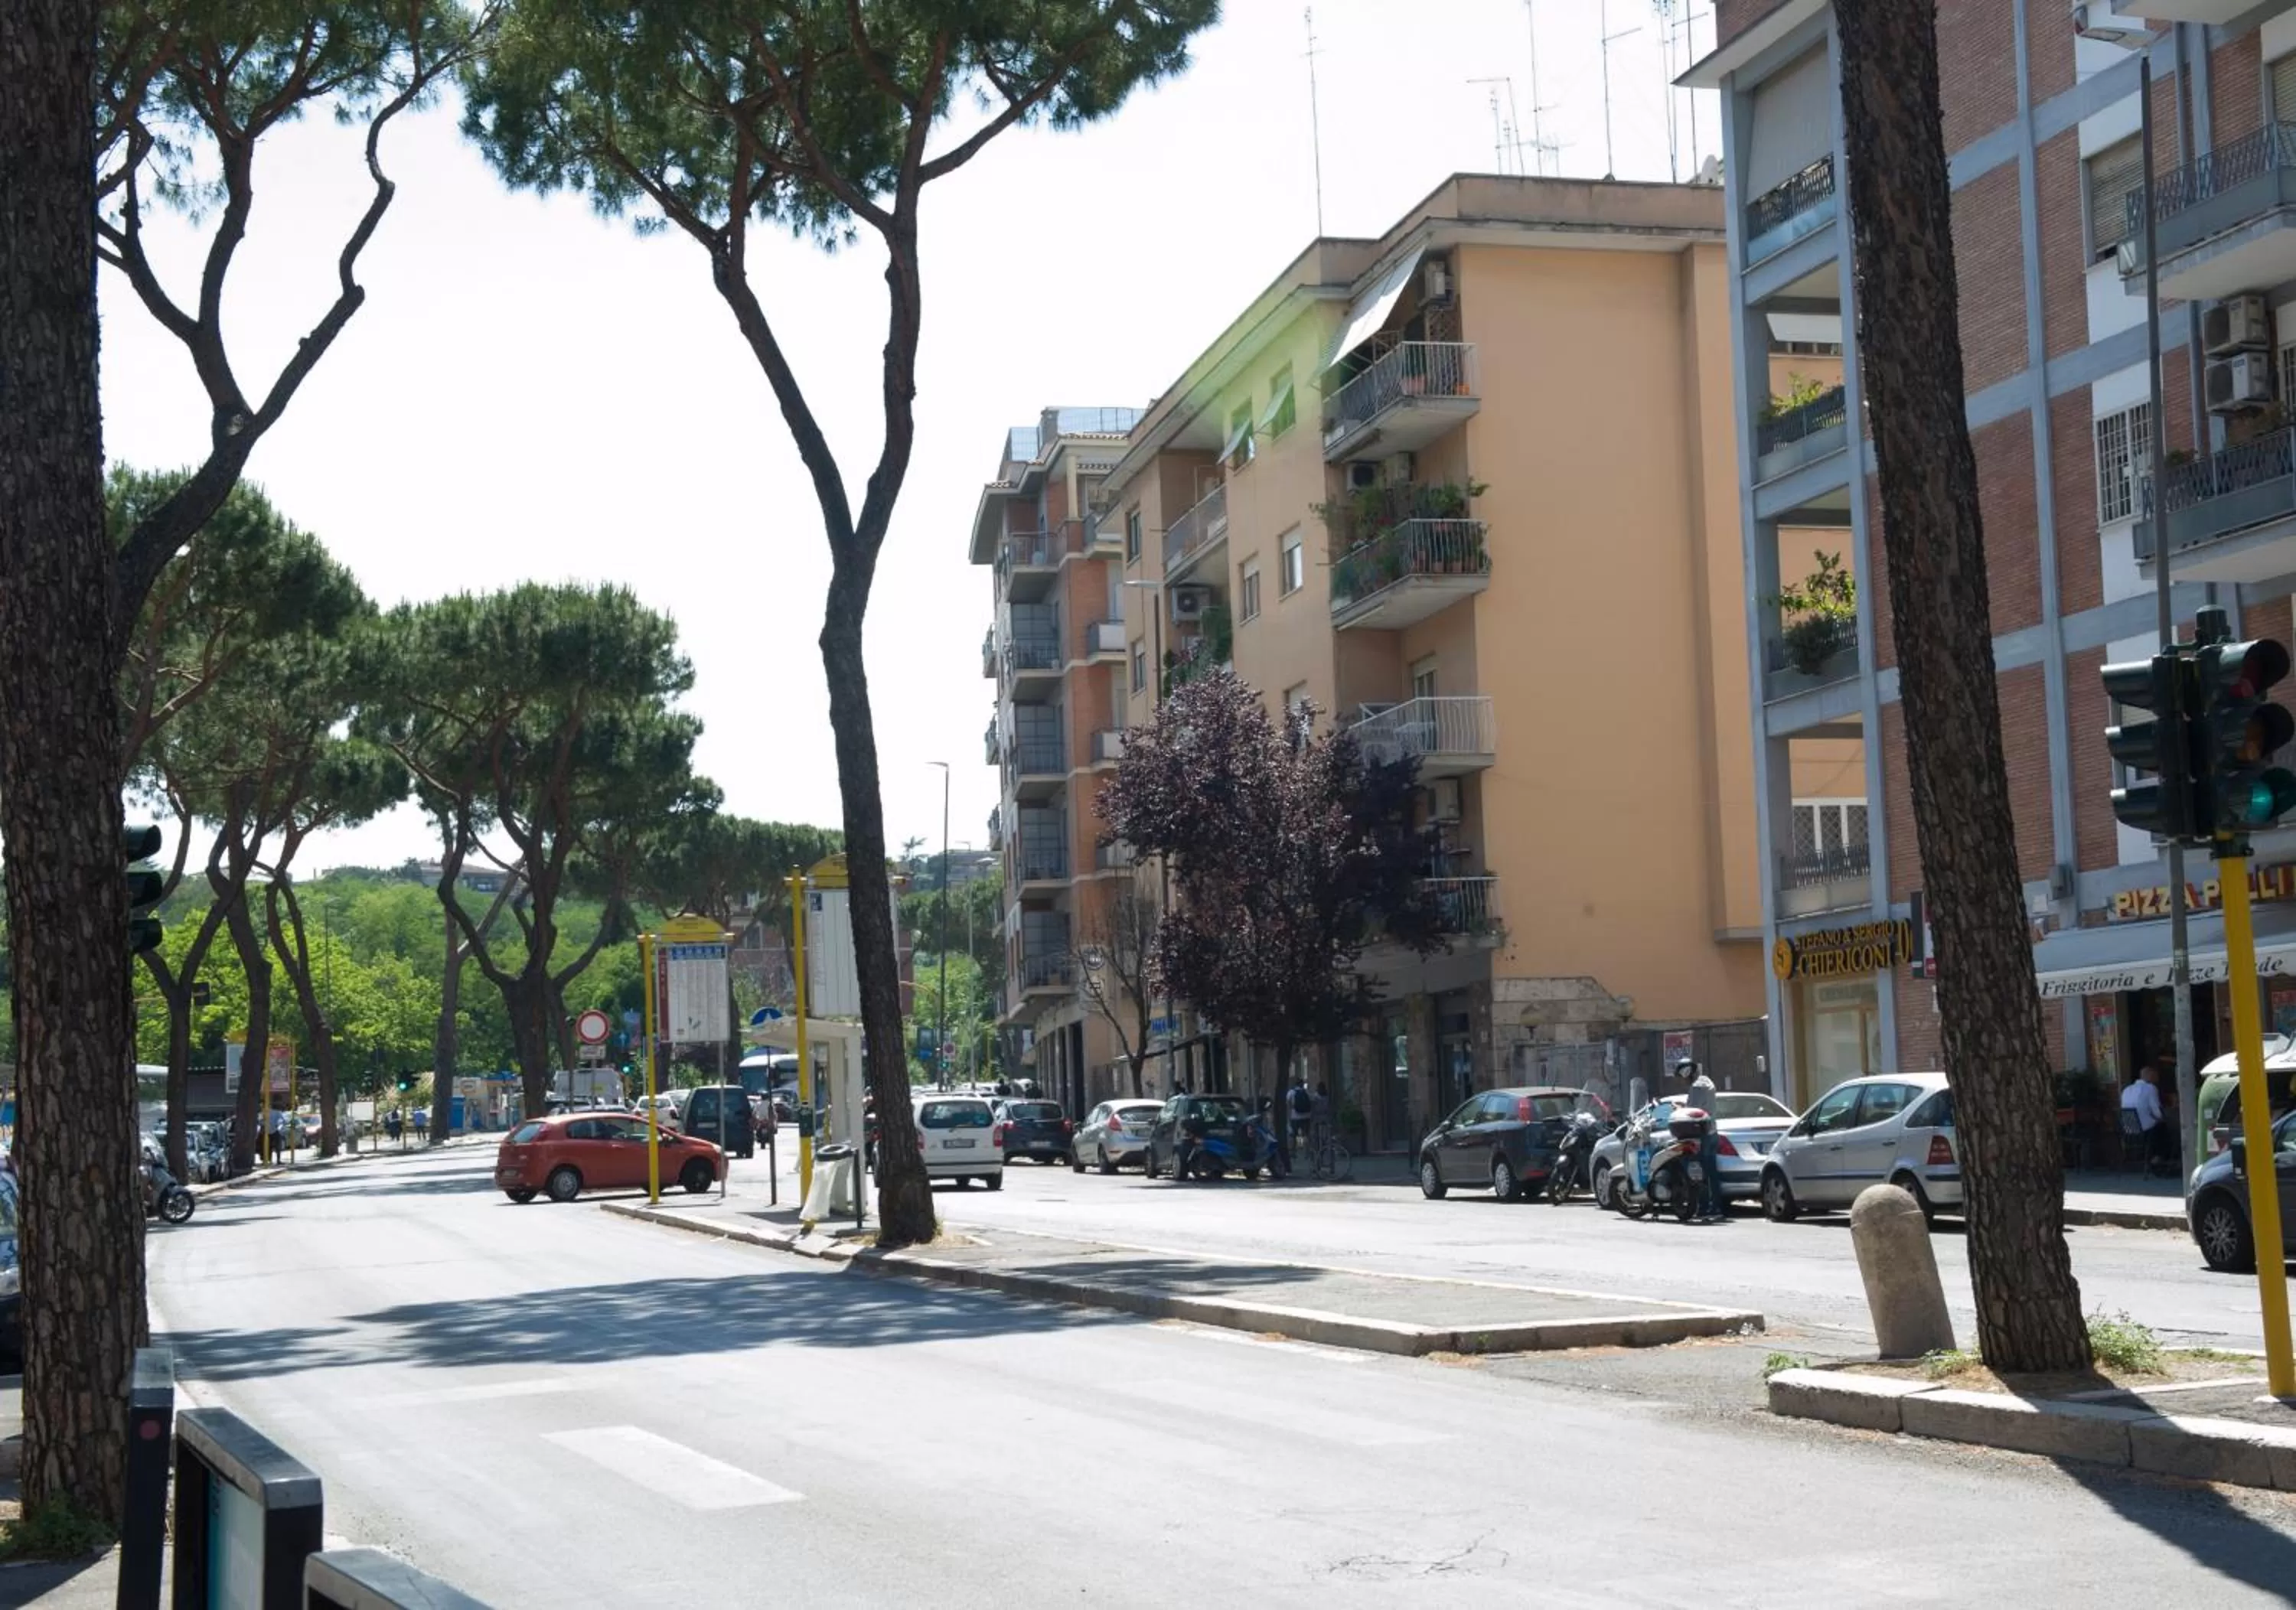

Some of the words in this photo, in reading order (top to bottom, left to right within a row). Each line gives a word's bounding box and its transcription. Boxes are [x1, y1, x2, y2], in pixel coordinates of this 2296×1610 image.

[2203, 866, 2288, 908] PLI
[1853, 919, 1894, 942] SERGIO
[2042, 973, 2135, 996] Friggitoria
[2144, 972, 2155, 985] e
